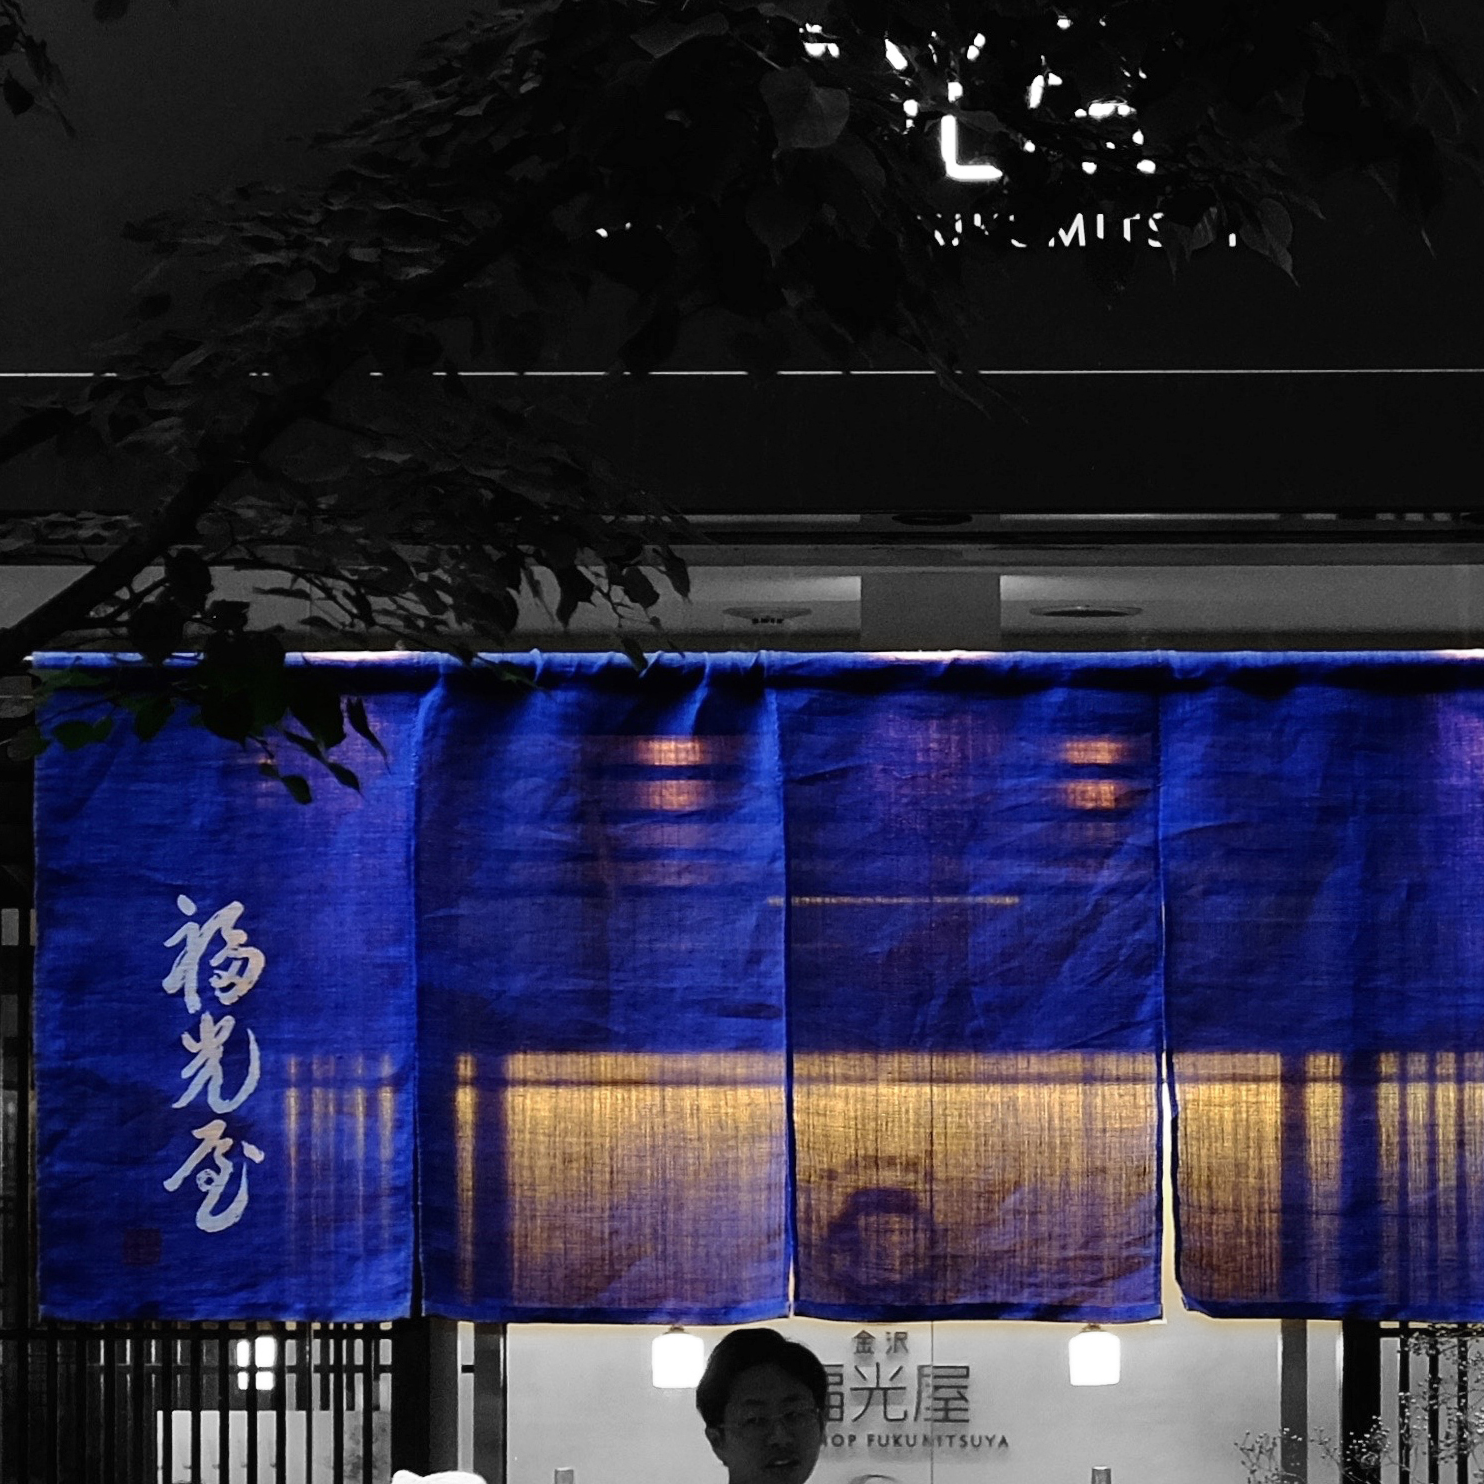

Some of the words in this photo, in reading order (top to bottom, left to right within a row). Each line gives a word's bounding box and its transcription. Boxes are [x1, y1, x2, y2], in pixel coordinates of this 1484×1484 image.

[162, 894, 266, 1233] 福光屋
[853, 1329, 909, 1355] 金沢
